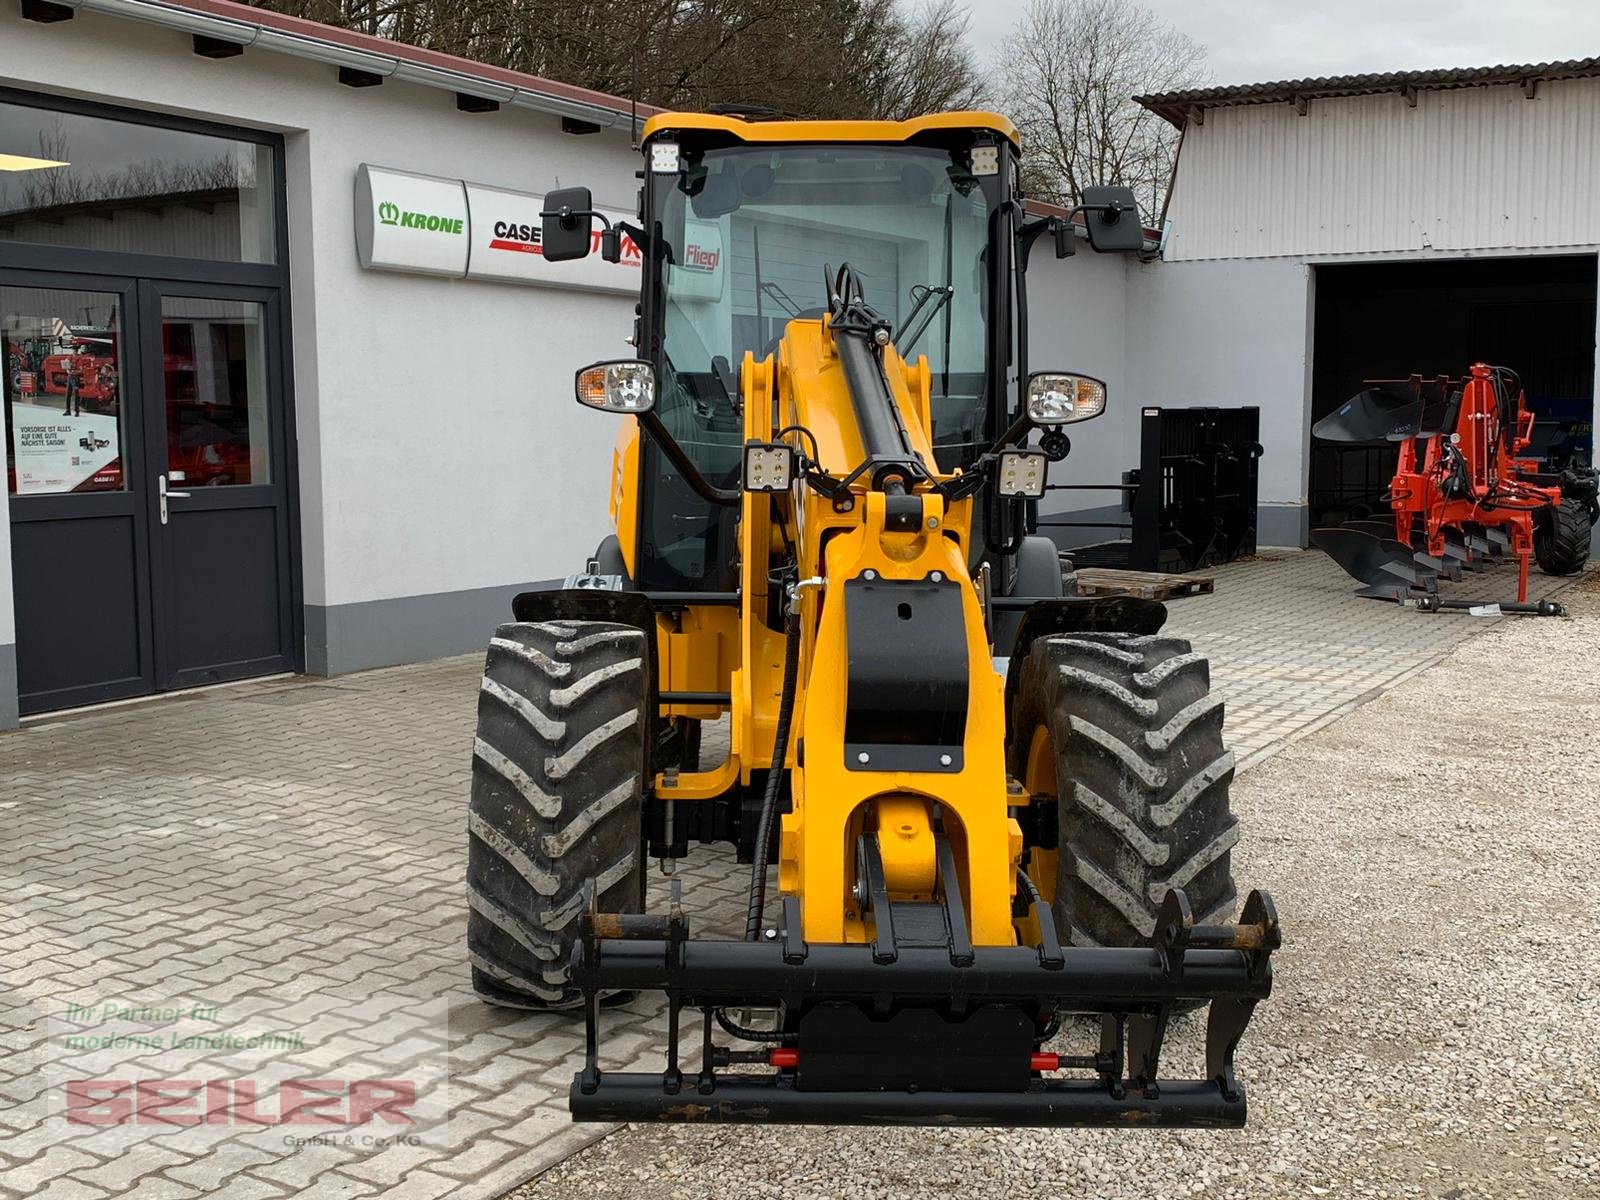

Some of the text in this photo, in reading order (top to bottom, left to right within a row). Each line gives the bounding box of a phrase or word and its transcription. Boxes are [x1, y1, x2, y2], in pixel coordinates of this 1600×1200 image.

[400, 211, 464, 234] KRONE
[494, 221, 541, 242] CASE
[686, 244, 720, 271] Fliegl
